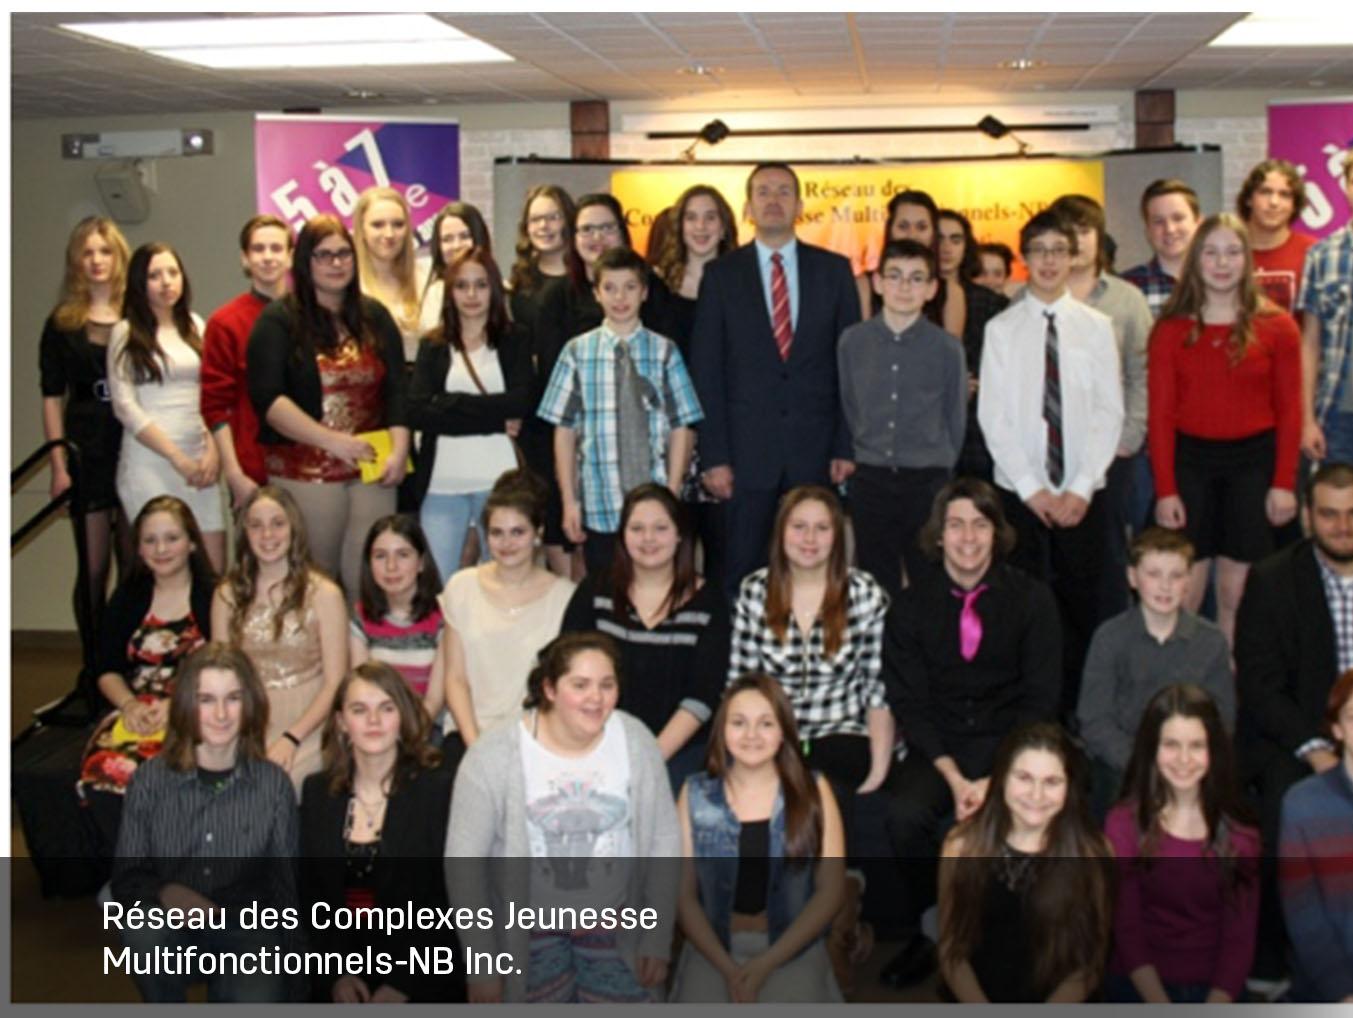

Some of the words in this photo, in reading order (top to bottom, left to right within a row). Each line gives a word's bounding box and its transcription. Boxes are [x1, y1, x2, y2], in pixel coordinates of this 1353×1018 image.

[343, 128, 390, 188] 7
[804, 180, 876, 199] Réseau
[881, 179, 911, 197] de
